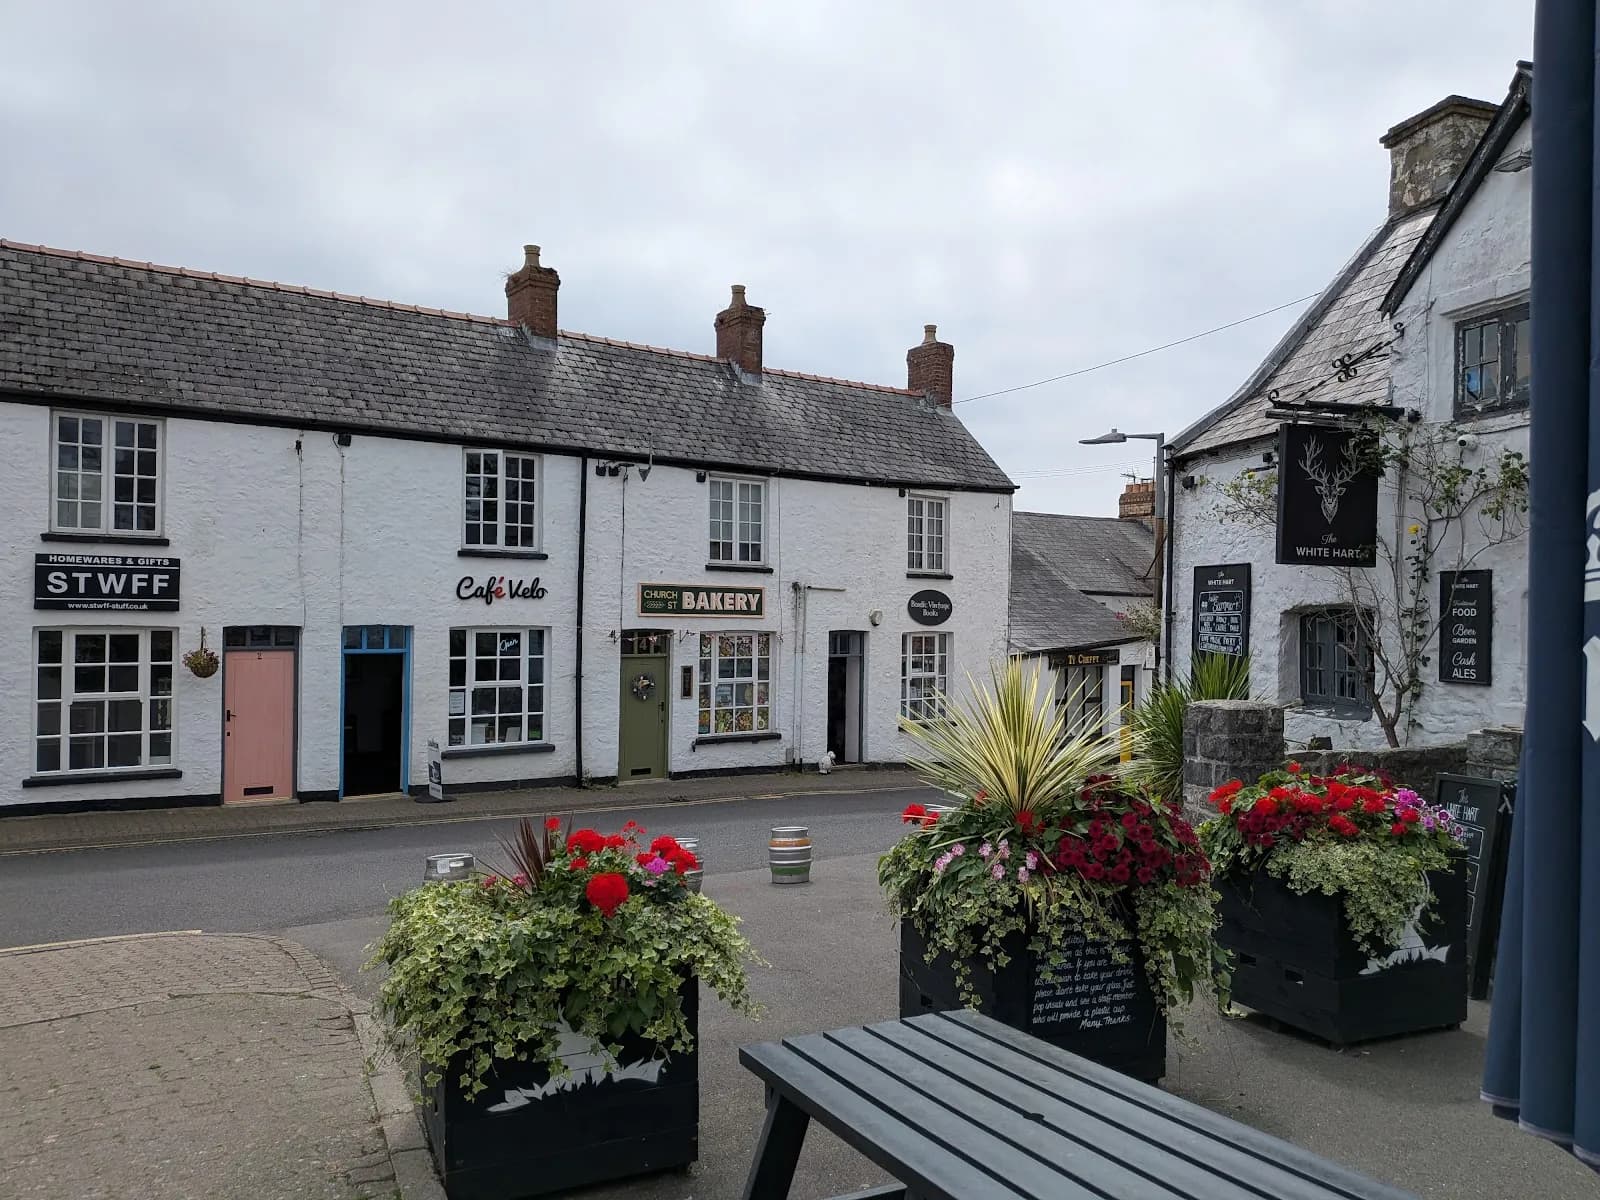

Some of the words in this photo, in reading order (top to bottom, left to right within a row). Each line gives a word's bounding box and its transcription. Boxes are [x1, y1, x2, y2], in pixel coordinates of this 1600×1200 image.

[1320, 533, 1337, 545] The
[1296, 547, 1330, 558] WHITE
[1332, 549, 1361, 559] HART
[49, 555, 122, 565] HOMEWARES
[138, 558, 170, 566] GIFTS
[46, 571, 170, 595] STWFF
[456, 576, 506, 605] Café
[508, 577, 549, 599] Velo
[67, 602, 149, 610] www.stwff-stuff.co.uk
[643, 590, 678, 599] CHURCH
[682, 591, 761, 611] BAKERY
[667, 601, 677, 609] ST
[922, 608, 939, 617] Books
[1452, 608, 1477, 617] FOOD
[1452, 623, 1476, 637] Beer
[500, 639, 519, 652] Open
[1452, 637, 1477, 645] GARDEN
[1452, 668, 1477, 679] ALES
[1462, 806, 1480, 822] HART
